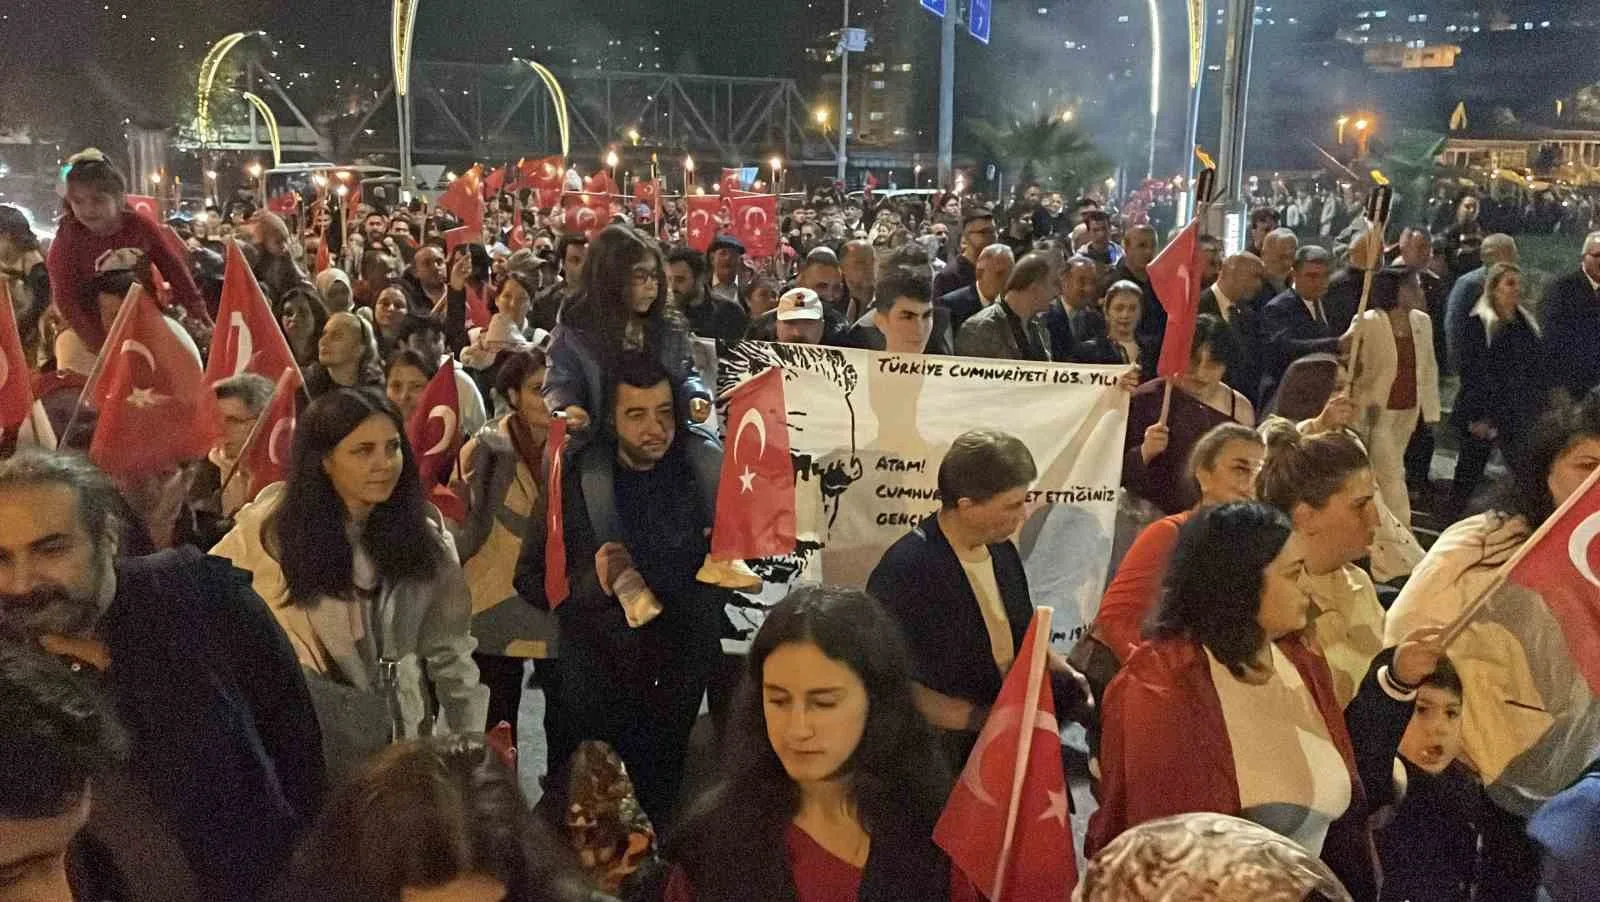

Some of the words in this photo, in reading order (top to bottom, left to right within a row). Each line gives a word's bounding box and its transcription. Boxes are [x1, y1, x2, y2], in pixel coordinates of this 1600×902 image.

[878, 356, 943, 375] TÜRKİYE
[949, 364, 1048, 383] CUMHURİYETİ
[875, 456, 926, 473] ATAM!
[1046, 485, 1115, 504] ETTİĞİNİZ
